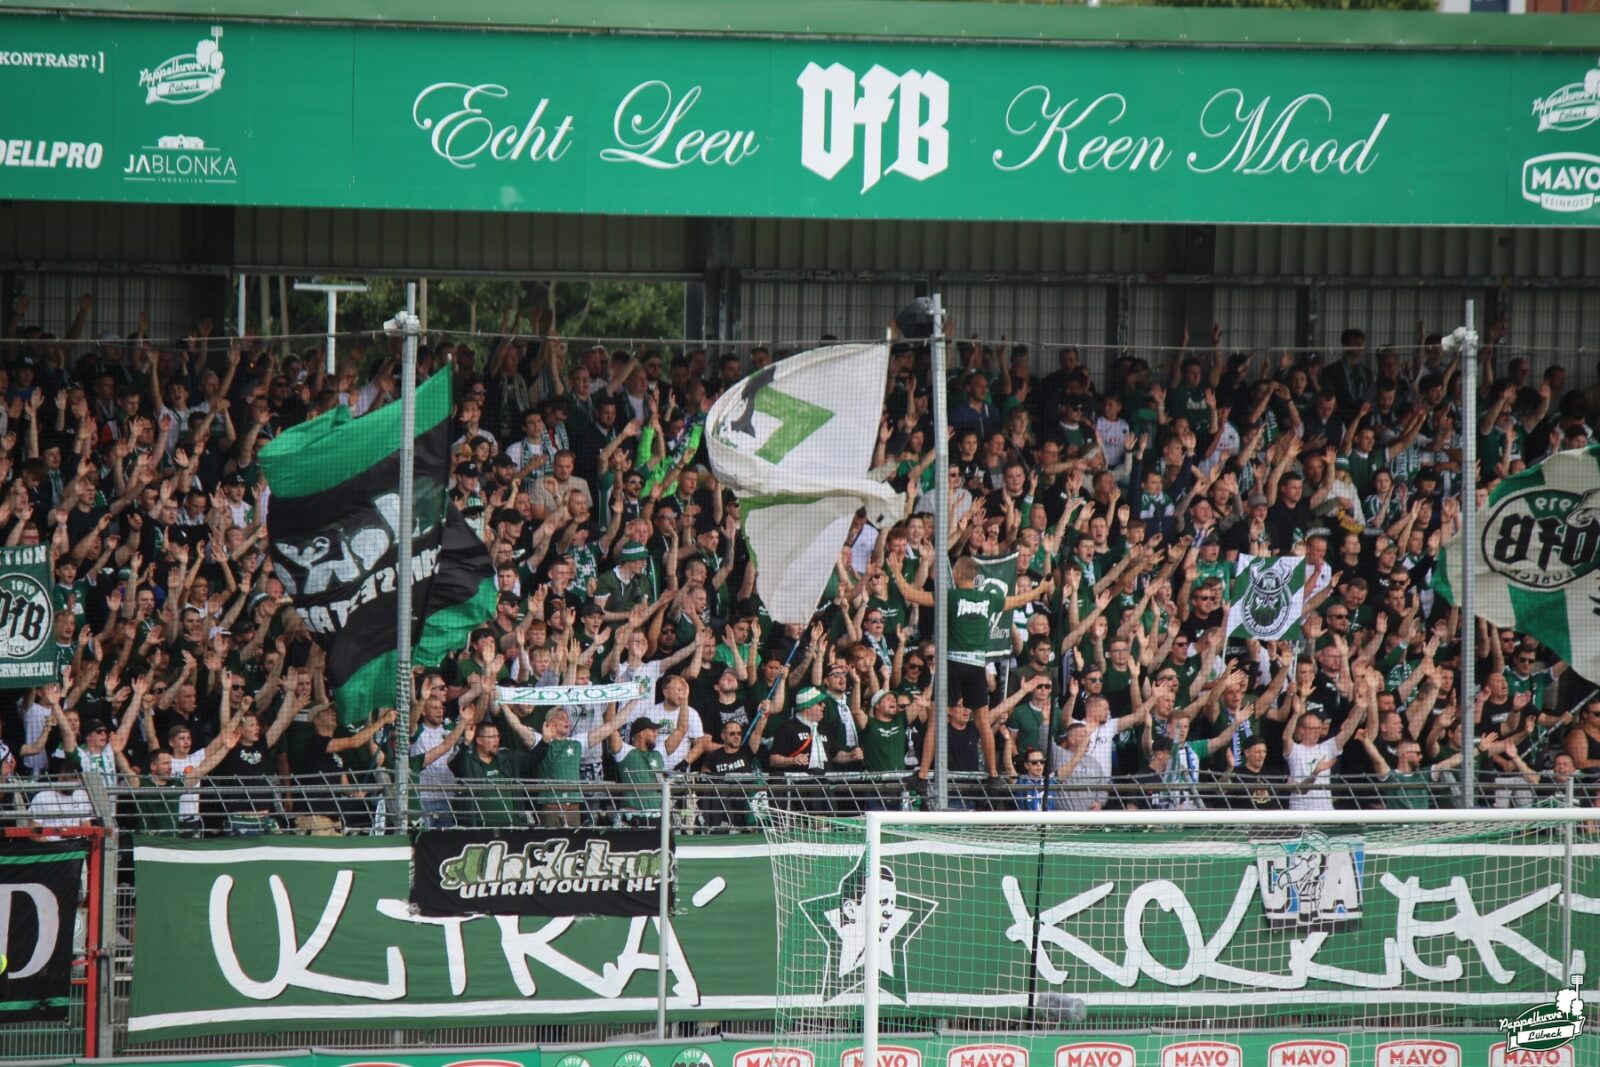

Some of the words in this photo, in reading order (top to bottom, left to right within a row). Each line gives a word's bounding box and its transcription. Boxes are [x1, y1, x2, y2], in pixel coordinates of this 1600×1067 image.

[413, 82, 574, 168] Echt
[600, 80, 760, 169] Leev
[992, 85, 1173, 174] Keen
[1187, 88, 1391, 175] Mood
[124, 154, 237, 176] JABLONKA
[1531, 166, 1600, 190] MAYO
[0, 545, 46, 566] TION
[540, 876, 620, 897] YOUTH
[747, 1056, 801, 1067] MAYO
[961, 1053, 1015, 1067] MAYO
[1068, 1051, 1122, 1067] MAYO
[1175, 1050, 1229, 1067] MAYO
[1282, 1049, 1336, 1066] MAYO
[1390, 1049, 1447, 1065] MAYO
[1503, 1050, 1561, 1065] MAYO
